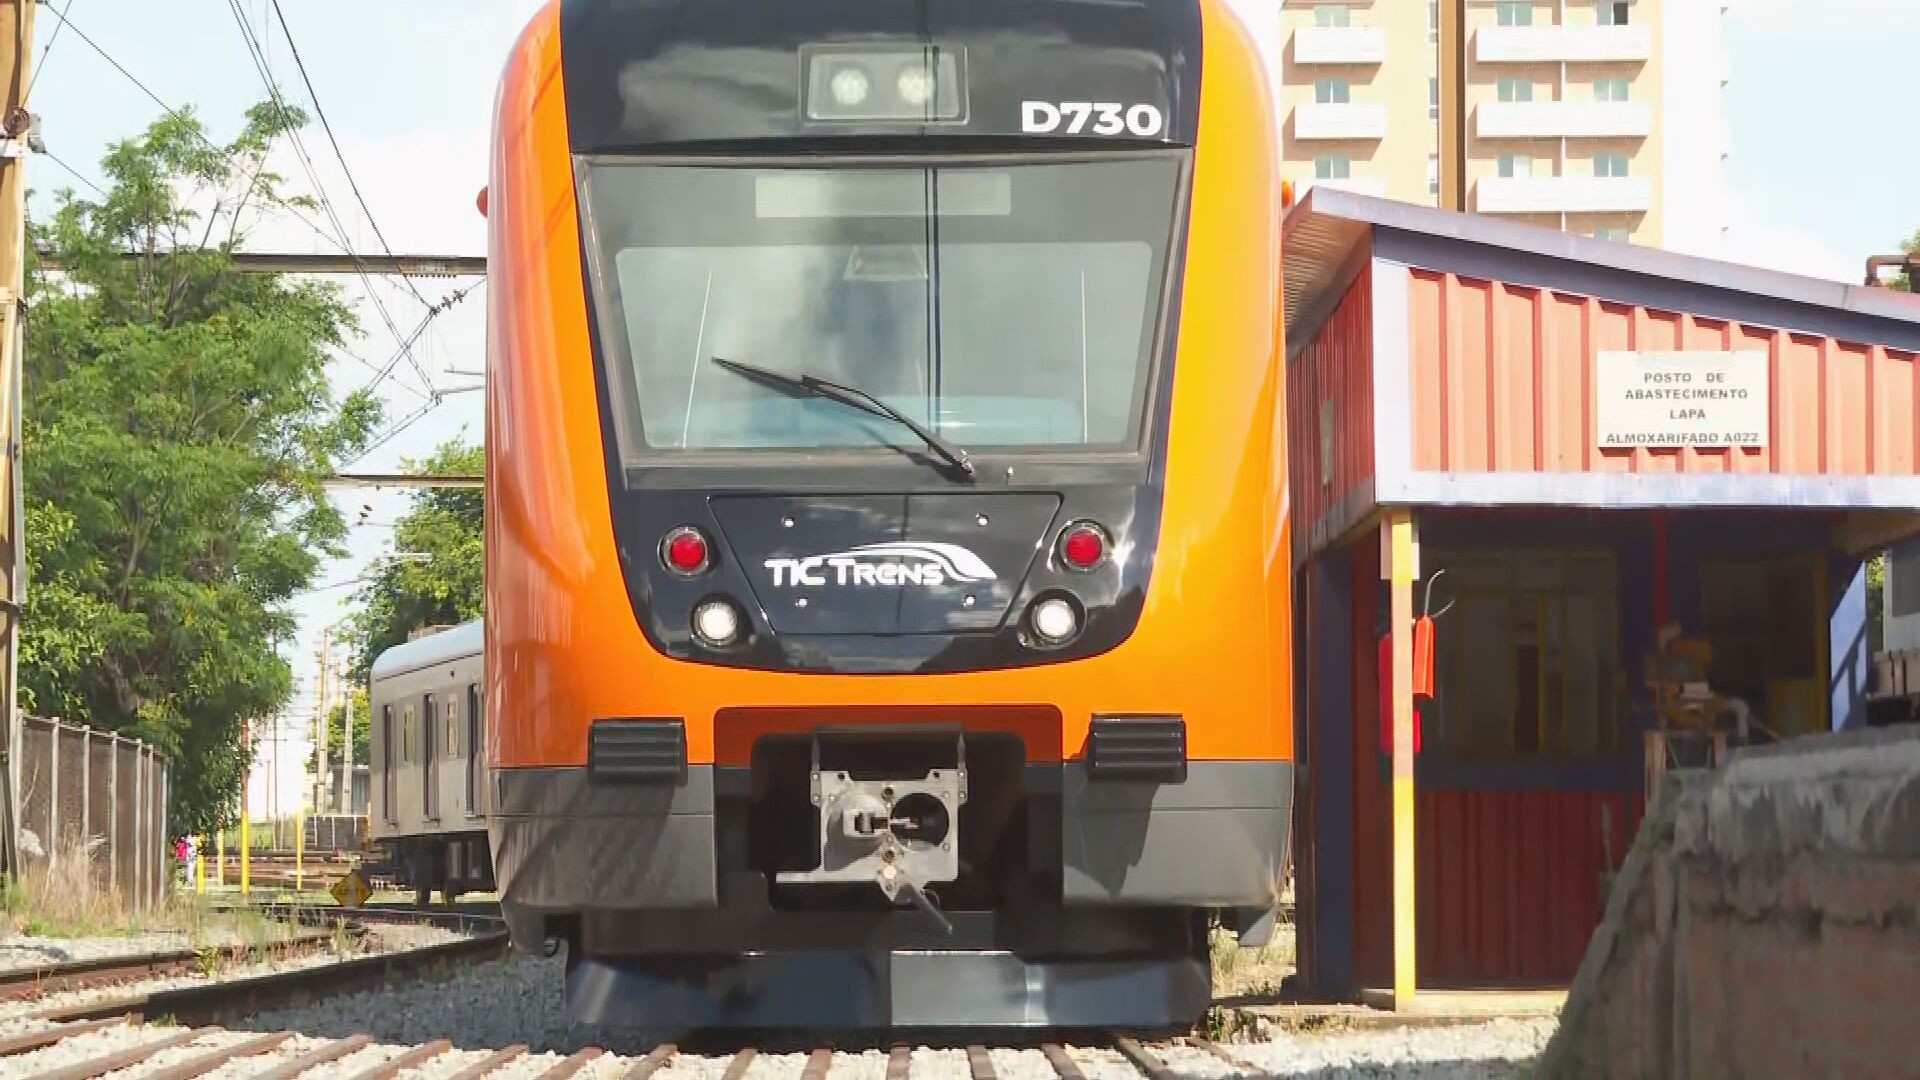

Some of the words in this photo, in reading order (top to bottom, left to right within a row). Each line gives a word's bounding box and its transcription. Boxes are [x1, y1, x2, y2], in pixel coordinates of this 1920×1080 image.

[1021, 100, 1162, 136] D730
[1643, 373, 1692, 383] POSTO
[1706, 373, 1724, 383] DE
[1625, 389, 1748, 400] ABASTECIMENTO
[1669, 409, 1706, 420] LAPA
[1606, 433, 1718, 444] ALMOXARIFADO
[1723, 433, 1759, 443] A022
[764, 558, 826, 587] TIC
